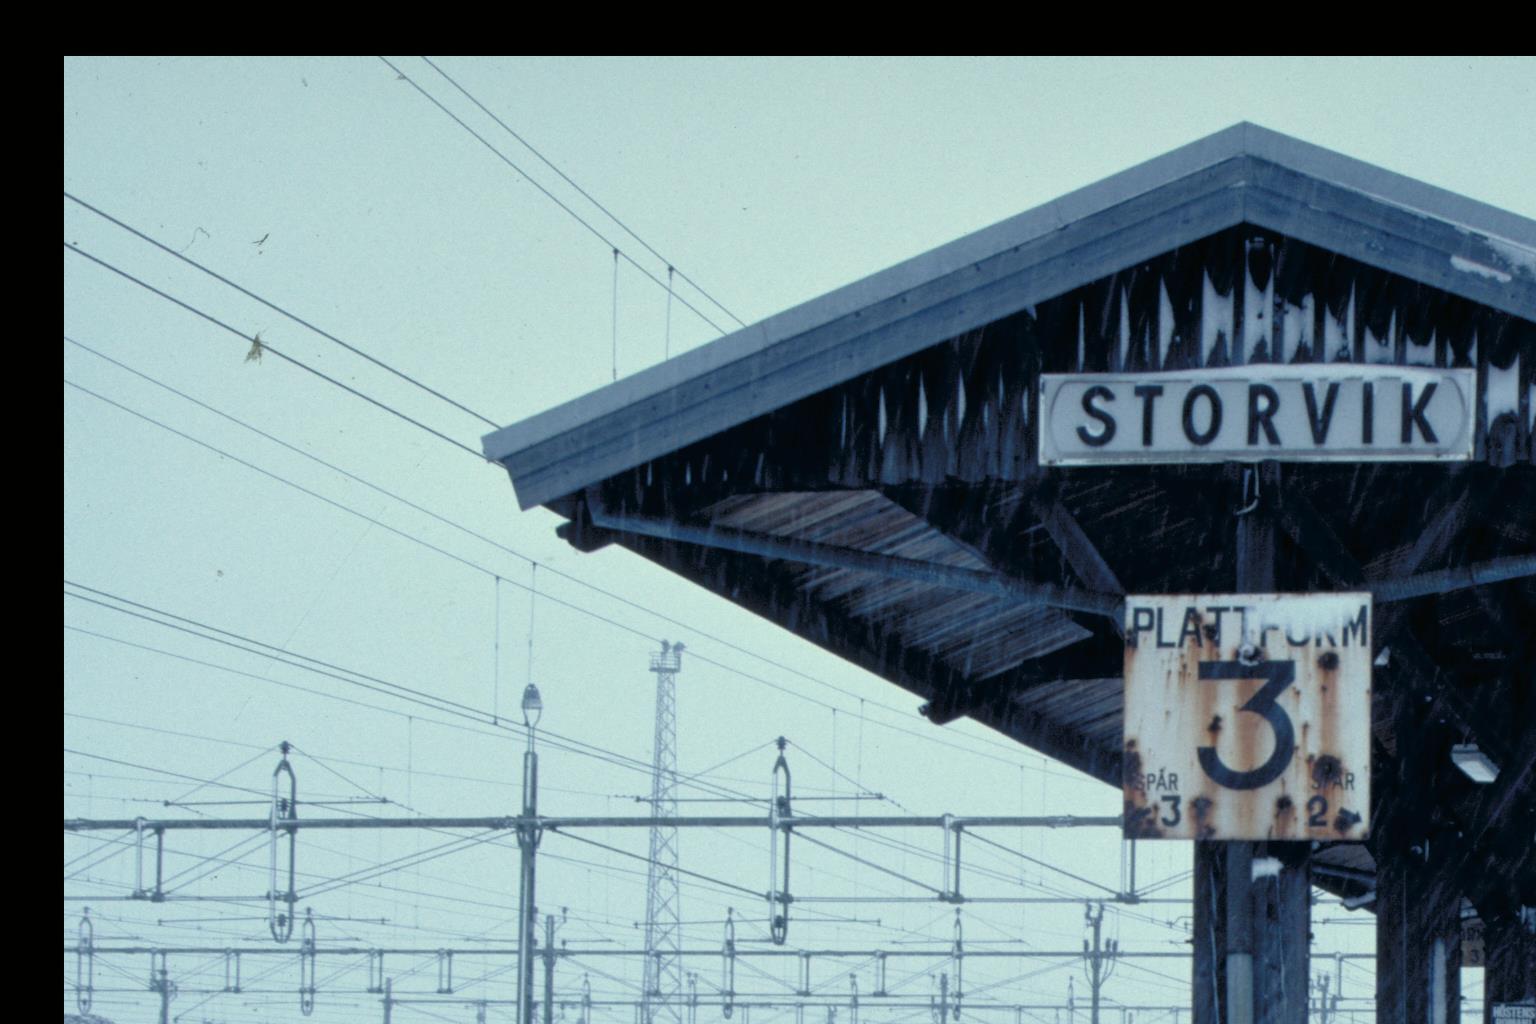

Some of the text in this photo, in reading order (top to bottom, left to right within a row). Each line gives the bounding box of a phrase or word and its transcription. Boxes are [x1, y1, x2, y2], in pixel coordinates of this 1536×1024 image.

[1076, 381, 1440, 448] STORVIK
[1197, 660, 1296, 791] 3
[1161, 795, 1182, 827] 3
[1308, 795, 1329, 827] 2
